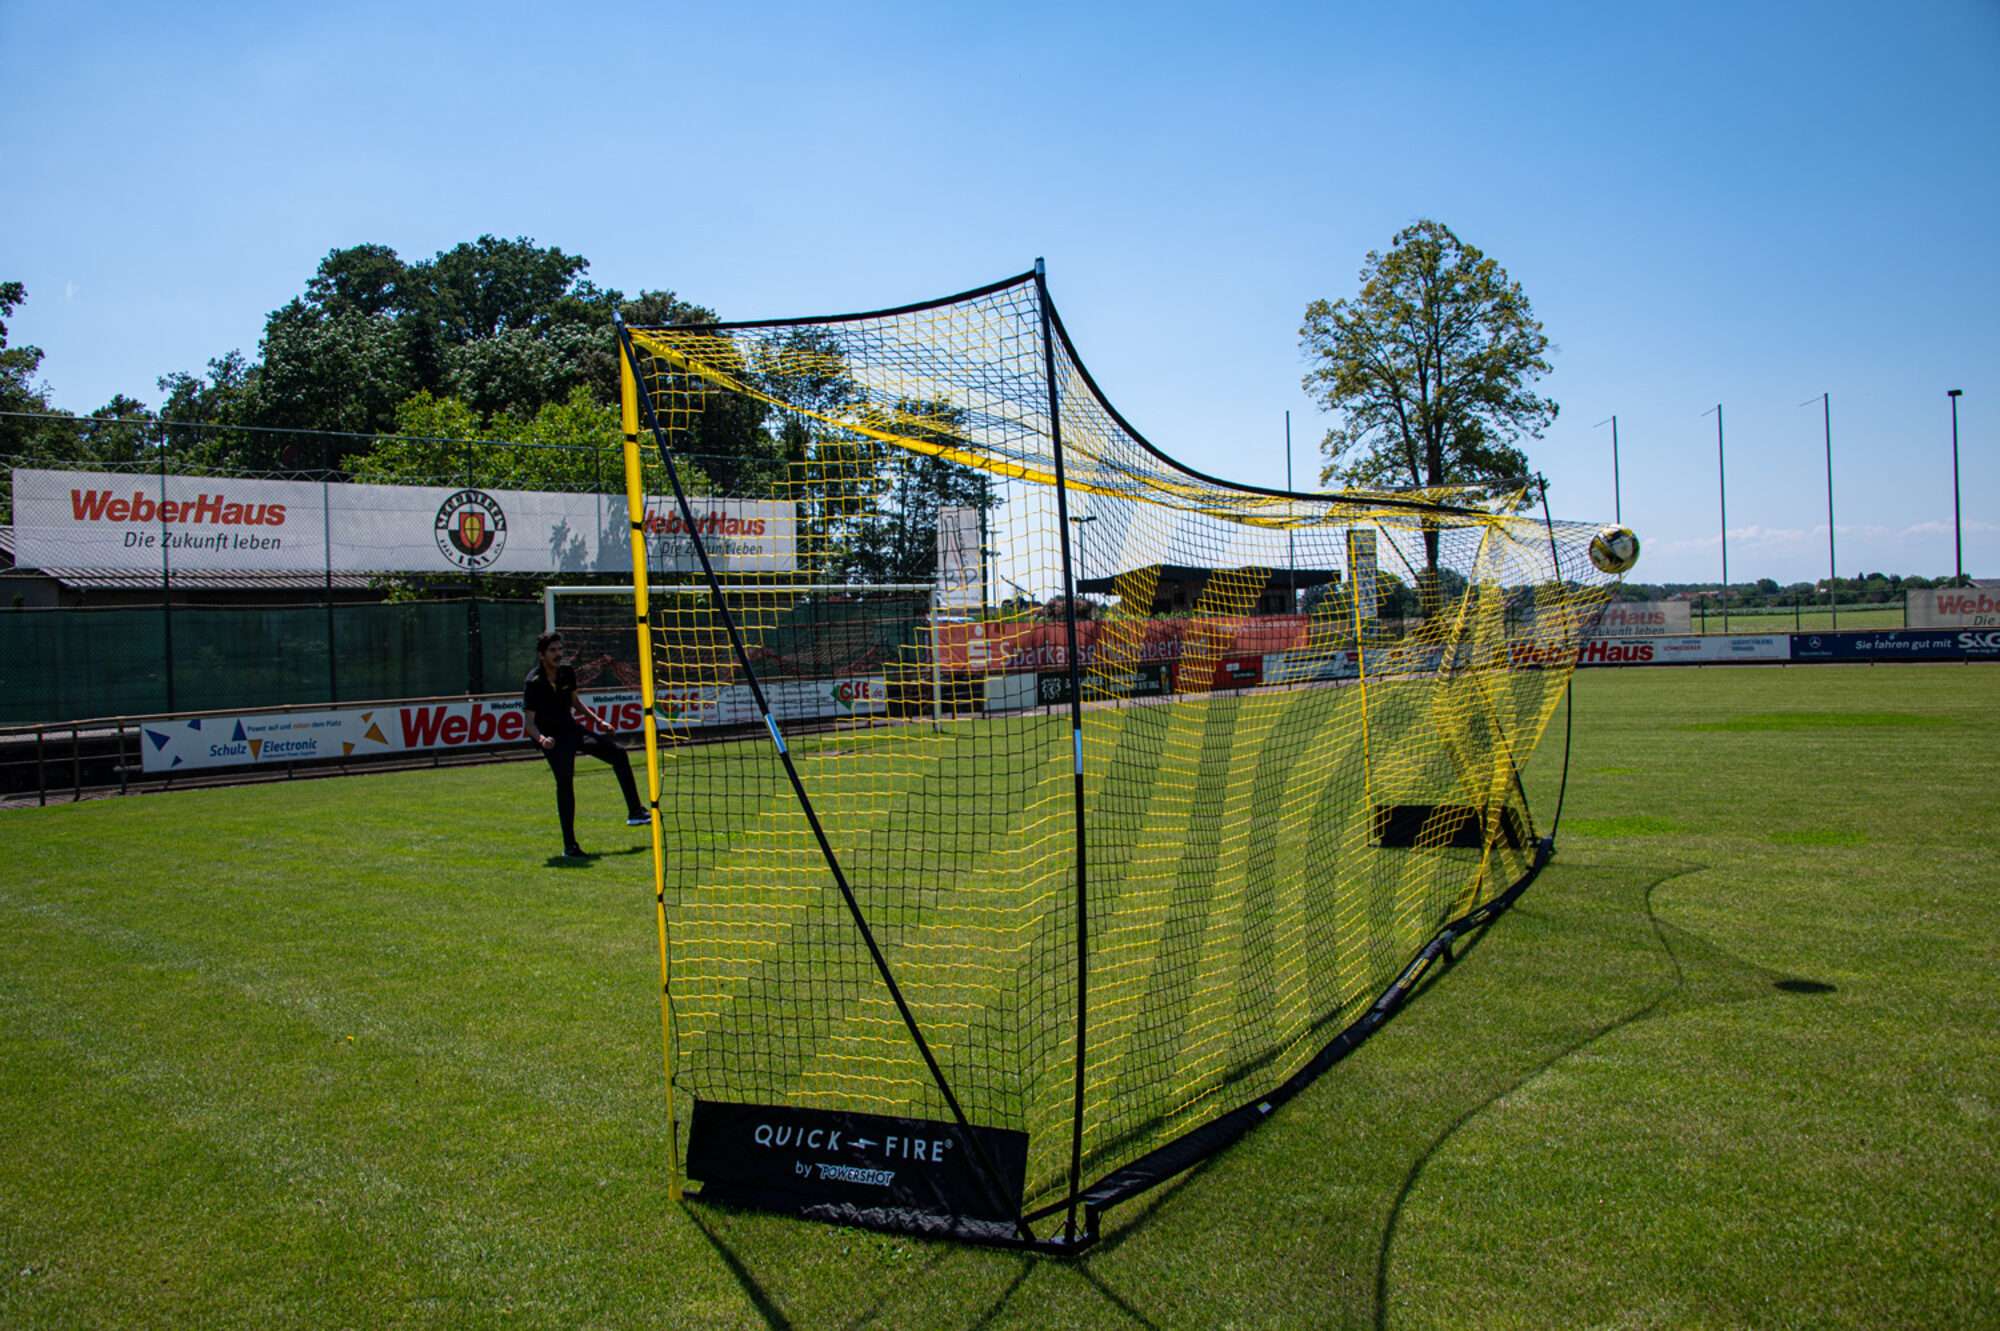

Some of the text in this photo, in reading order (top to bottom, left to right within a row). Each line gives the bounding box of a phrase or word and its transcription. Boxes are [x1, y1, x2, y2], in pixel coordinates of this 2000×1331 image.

[70, 489, 288, 525] WeberHaus
[124, 531, 281, 553] Die Zukunft leben
[1000, 640, 1097, 667] Sparkase
[1855, 639, 1873, 650] Sie
[1874, 637, 1910, 650] fahren
[1911, 639, 1930, 651] gut
[1932, 638, 1952, 649] mit
[209, 743, 247, 757] Schulz
[263, 738, 318, 753] Electronic
[754, 1124, 843, 1151] QUICK
[796, 1160, 895, 1187] by POWERSHOT
